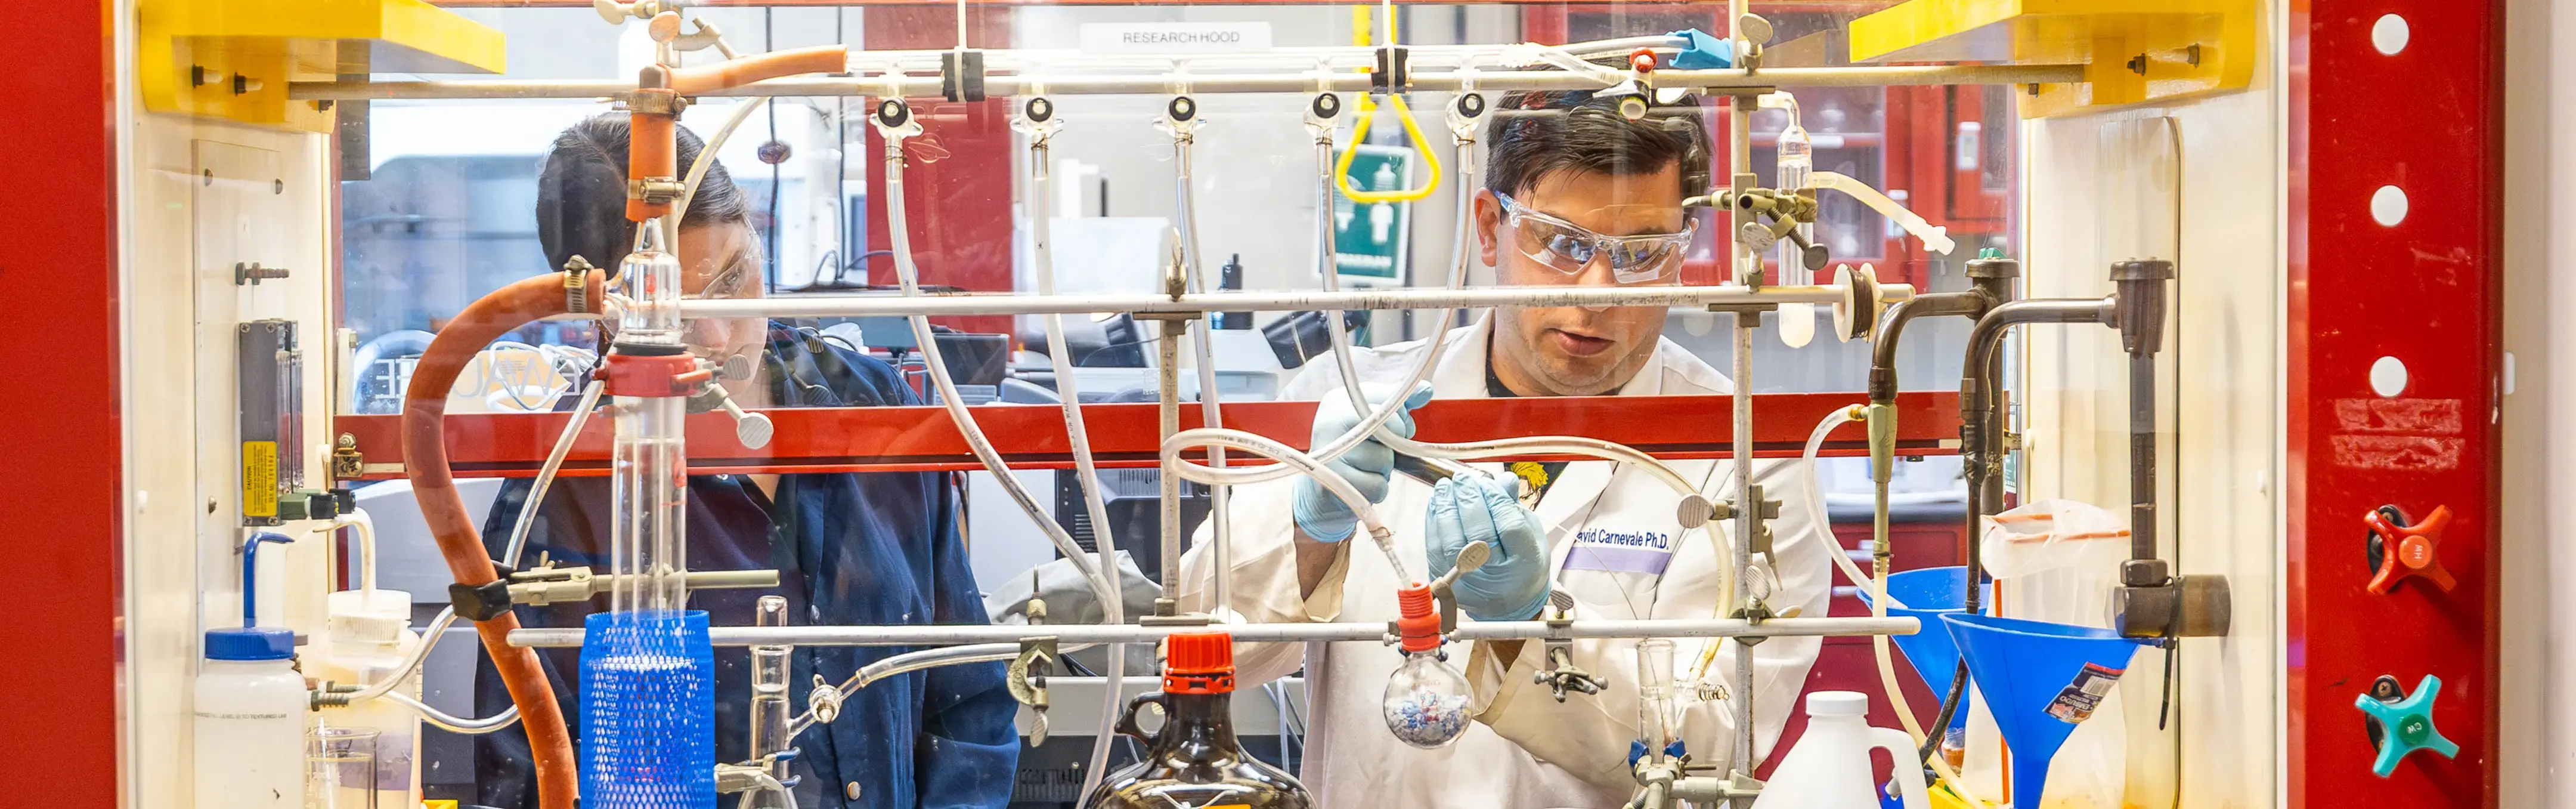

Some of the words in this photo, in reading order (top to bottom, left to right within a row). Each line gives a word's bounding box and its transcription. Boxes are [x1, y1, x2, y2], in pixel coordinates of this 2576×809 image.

[1123, 32, 1197, 44] RESEARCH
[1200, 32, 1240, 43] HOOD
[1576, 528, 1597, 543] avid
[1599, 529, 1643, 546] Carnevale
[1645, 532, 1669, 550] Ph.D.
[2407, 722, 2423, 734] CW
